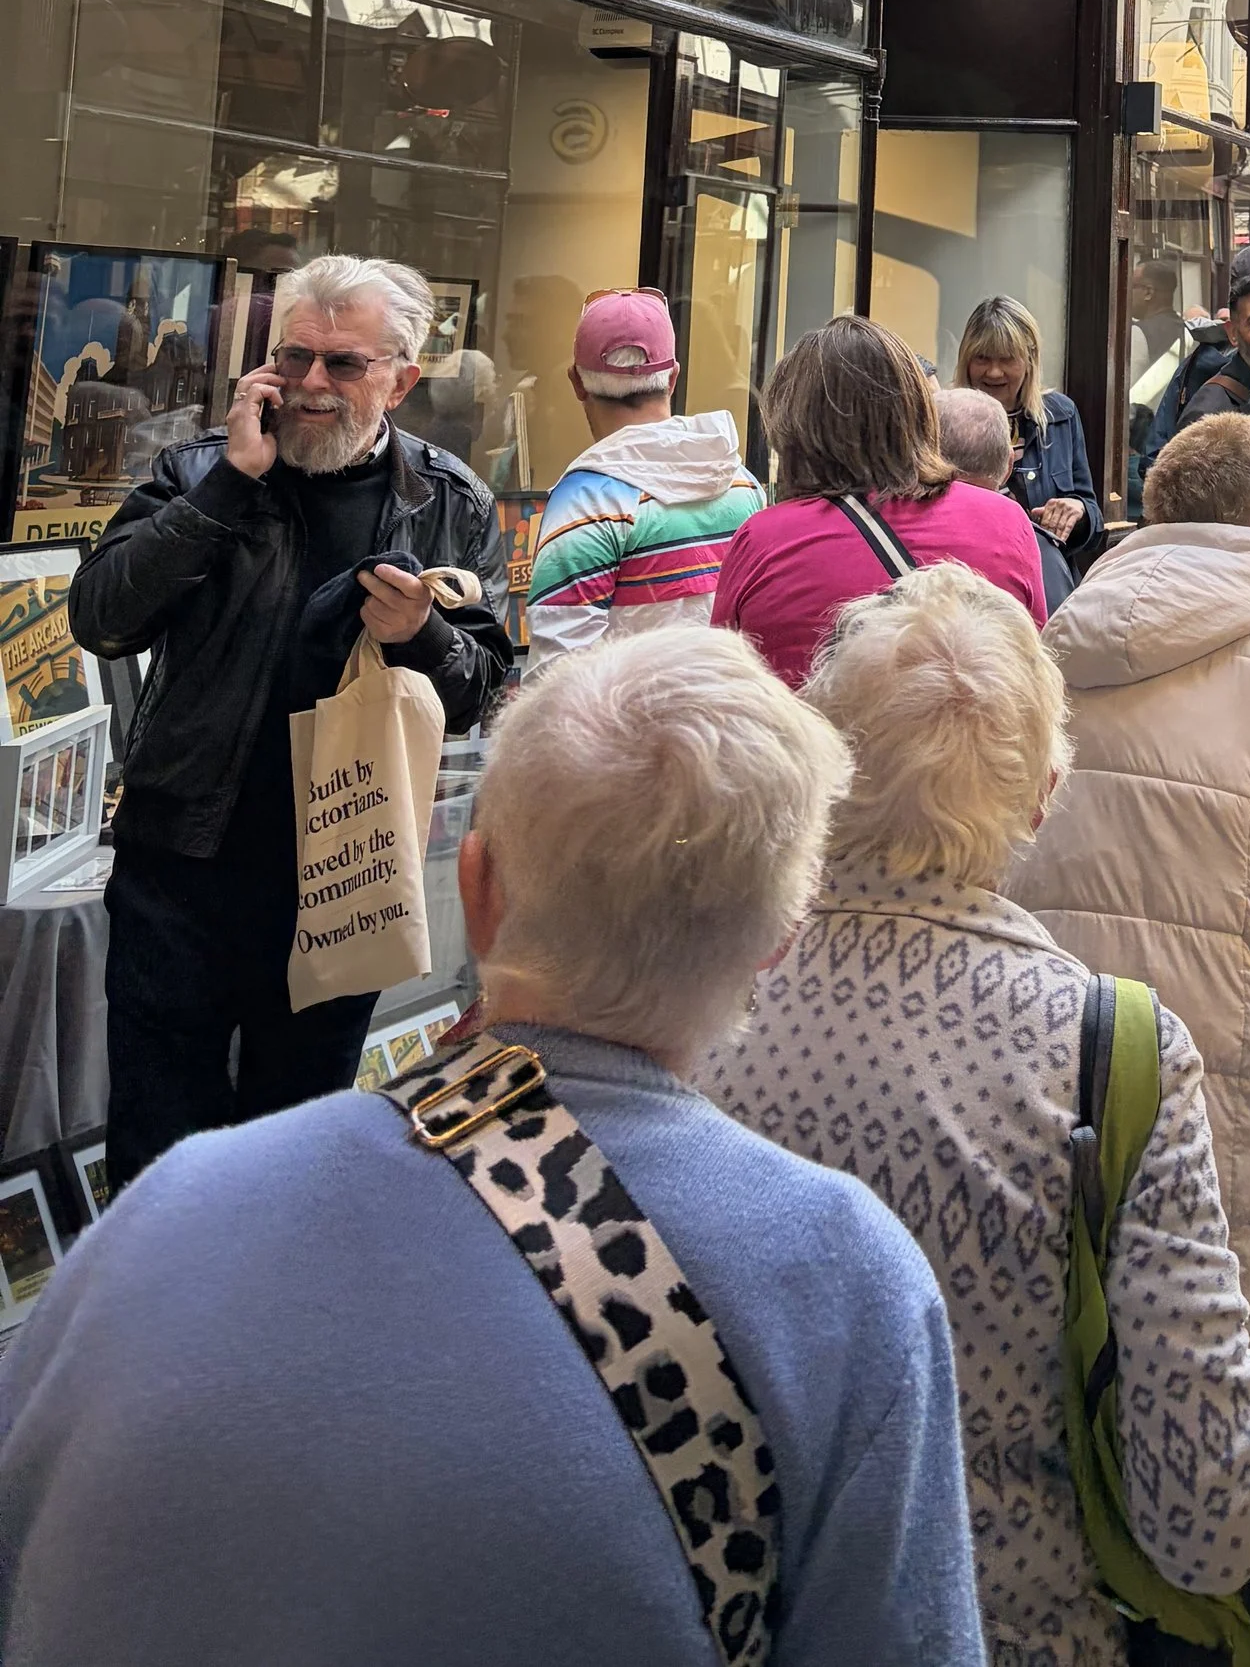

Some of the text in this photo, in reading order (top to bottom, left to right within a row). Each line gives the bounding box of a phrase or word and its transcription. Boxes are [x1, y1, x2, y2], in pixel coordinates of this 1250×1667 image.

[4, 638, 29, 671] THE
[355, 759, 374, 785] by
[305, 787, 389, 835] ictorians.
[302, 828, 396, 882] aved by the
[297, 902, 409, 954] Owned by you.
